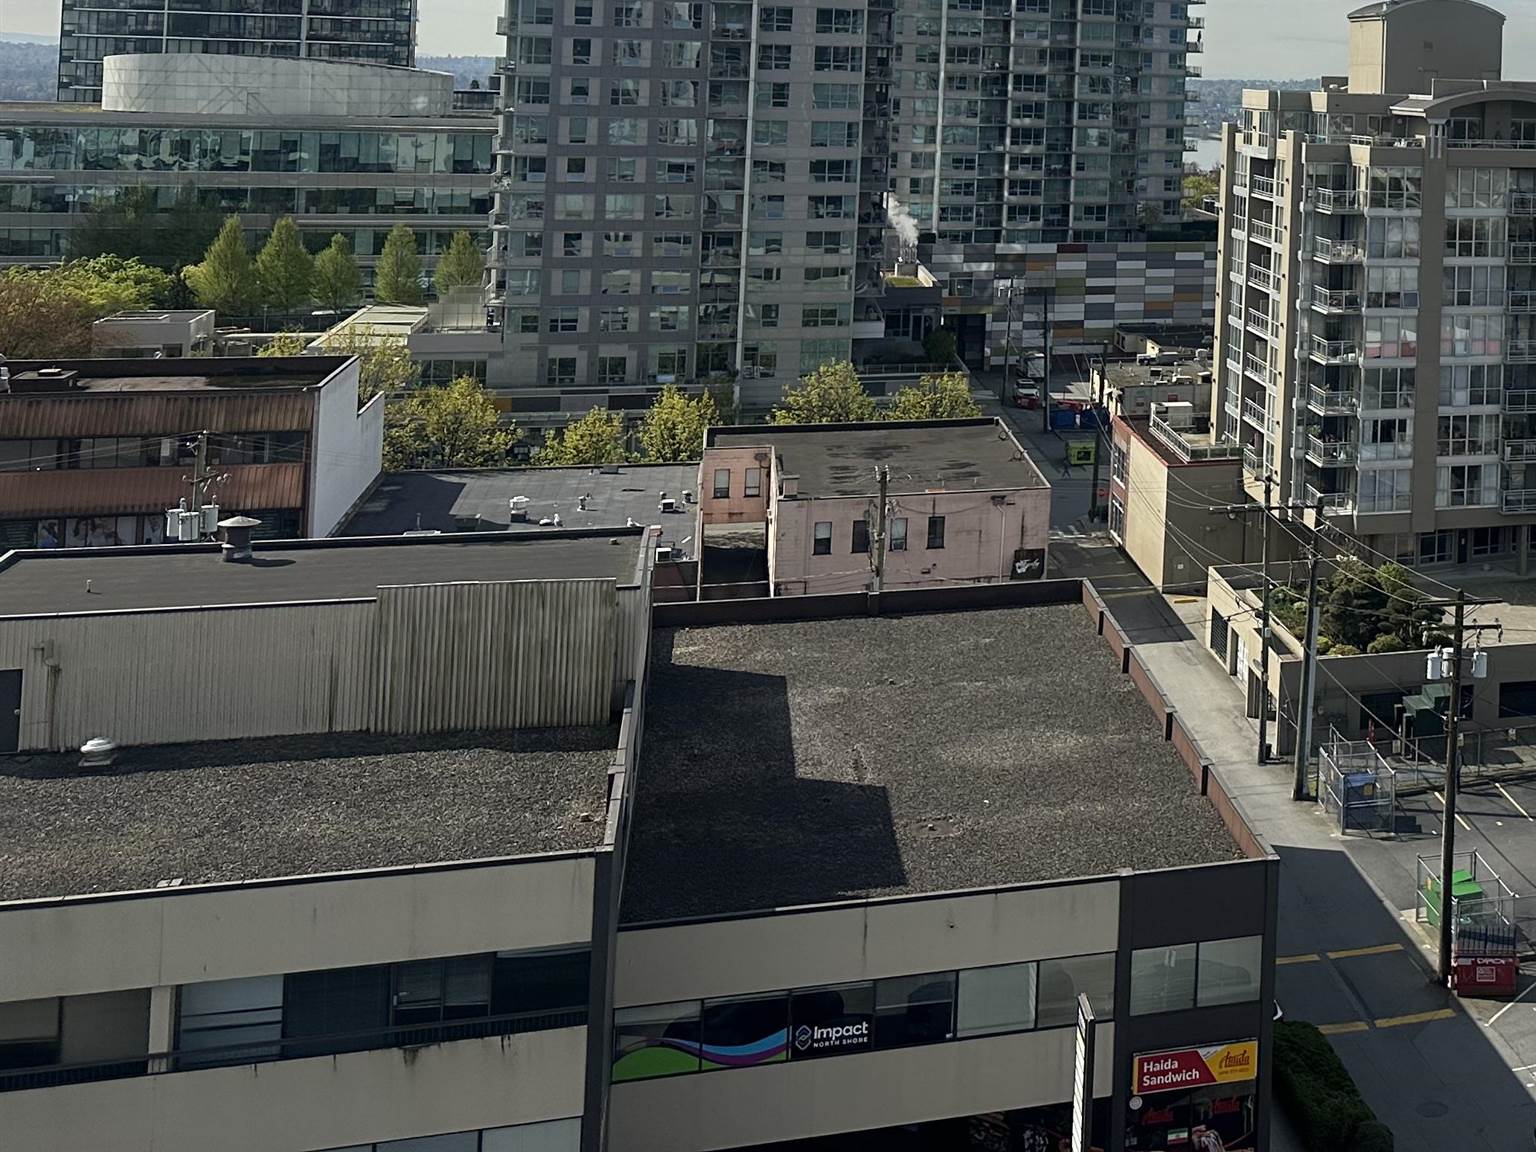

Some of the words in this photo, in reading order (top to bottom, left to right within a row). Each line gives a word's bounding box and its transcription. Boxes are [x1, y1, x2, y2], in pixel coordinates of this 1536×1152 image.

[813, 1021, 869, 1040] Impact
[813, 1039, 840, 1048] NORTH
[842, 1036, 868, 1045] SHORE
[1143, 1058, 1179, 1073] Haida
[1142, 1068, 1200, 1086] Sandwich
